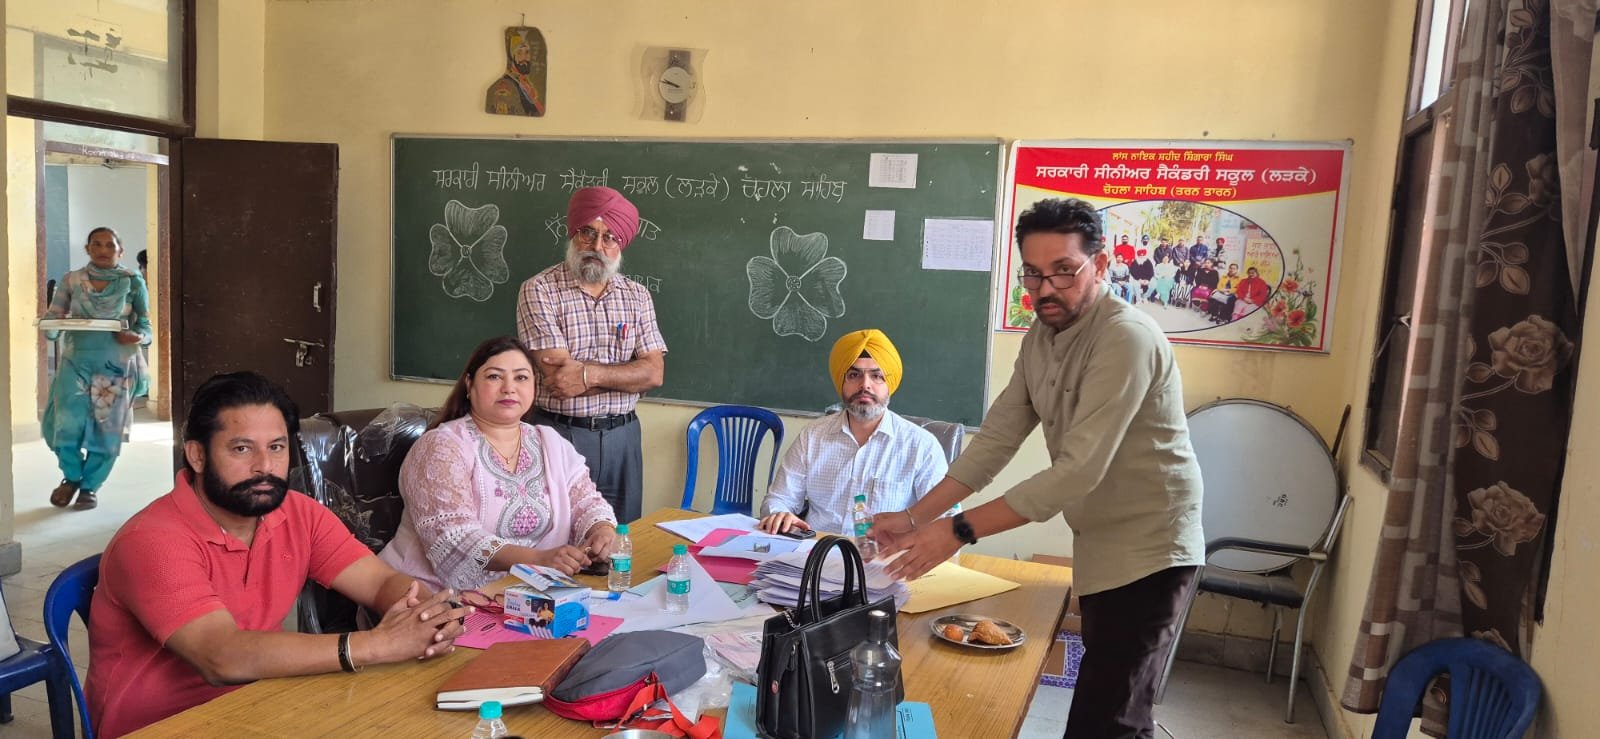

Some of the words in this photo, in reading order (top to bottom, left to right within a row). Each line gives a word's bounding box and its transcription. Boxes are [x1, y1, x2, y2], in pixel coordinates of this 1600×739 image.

[1131, 150, 1156, 161] ਨਾਇਕ
[1215, 151, 1234, 163] ਸਿੰਘ
[432, 161, 480, 191] ਸਰਕਾਰੀ
[485, 165, 547, 193] ਸੀਨੀਅਰ
[801, 173, 848, 204] ਸਾਹਿਬ
[1035, 163, 1089, 179] ਸਰਕਾਰੀ
[1094, 163, 1152, 180] ਸੀਨੀਅਰ
[1156, 163, 1210, 182] ਸੈਕੰਡਰੀ
[1215, 168, 1256, 186] ਸਕੂਲ
[1261, 166, 1317, 186] (ਲੜਕੇ)
[1103, 183, 1131, 195] ਚੋਹਲਾ
[1134, 184, 1167, 196] ਸਾਹਿਬ
[1170, 185, 1201, 197] (ਤਰਨ
[1204, 187, 1237, 199] ਤਾਰਨ)
